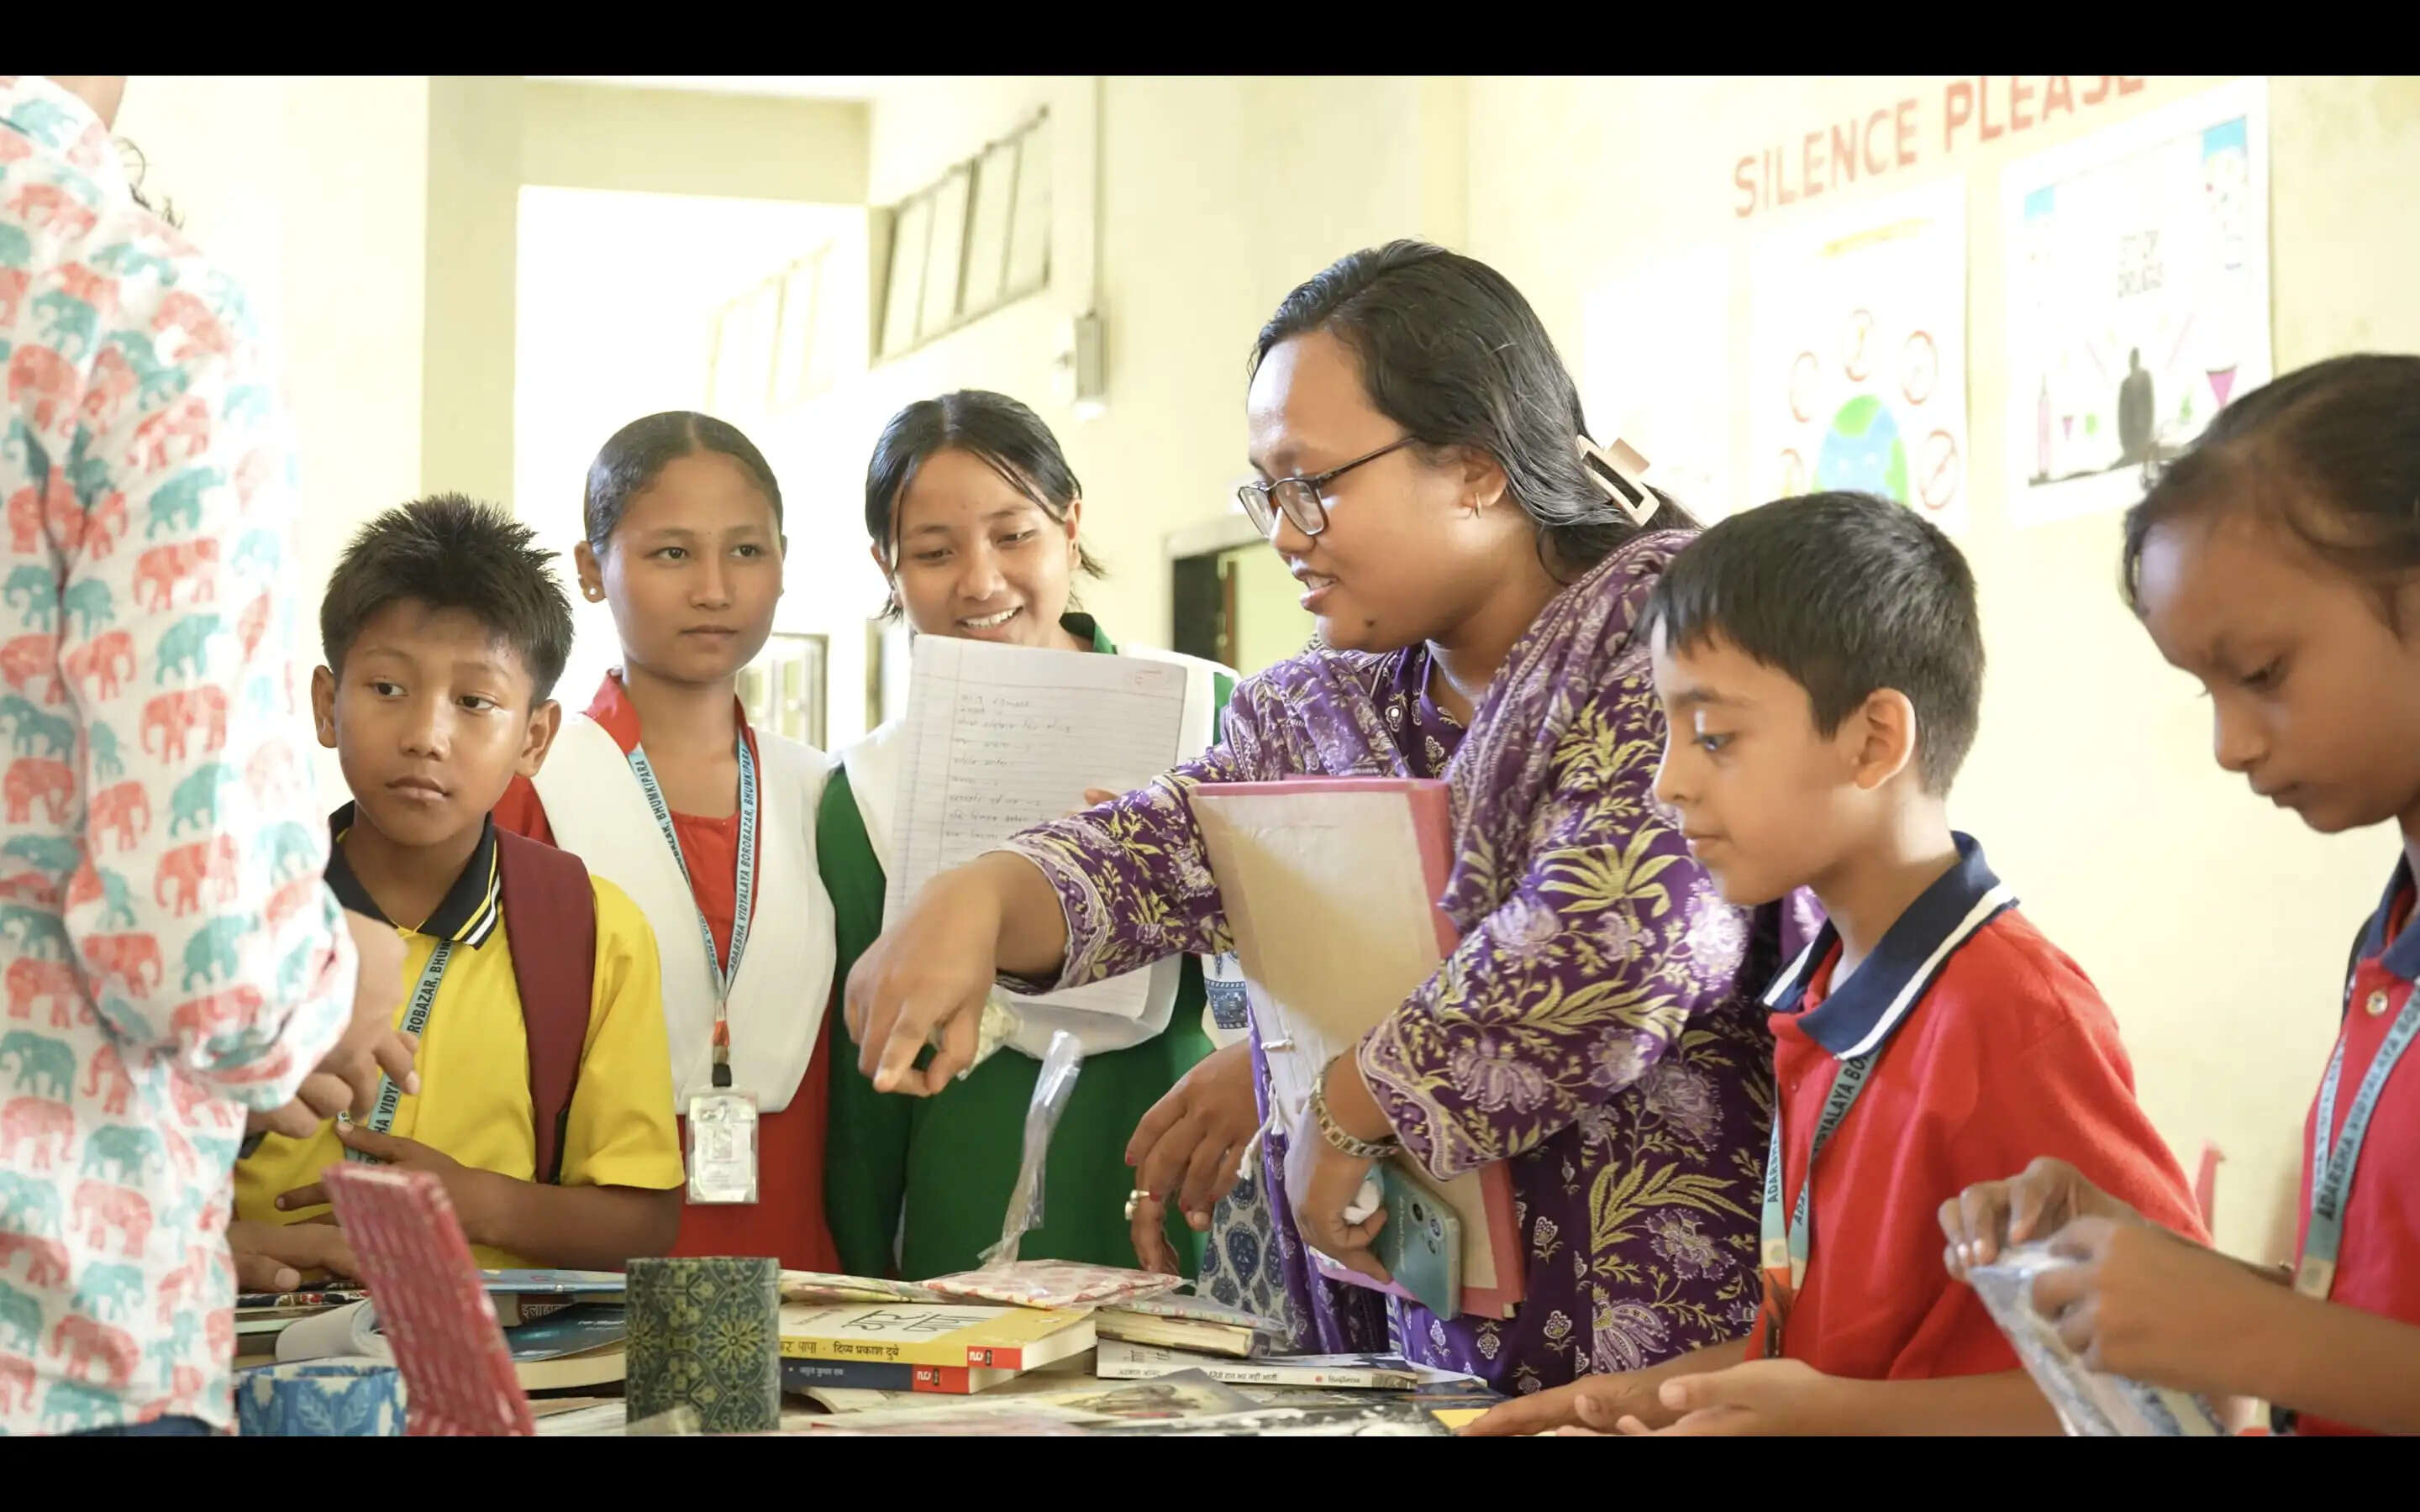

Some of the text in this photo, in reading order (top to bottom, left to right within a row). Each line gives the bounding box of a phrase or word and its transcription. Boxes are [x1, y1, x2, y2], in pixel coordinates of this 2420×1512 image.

[1734, 97, 1918, 218] SILENCE
[635, 759, 668, 822] BHUMKIPARA
[740, 808, 756, 869] BOROBAZAR,
[737, 869, 752, 921] VIDYALAYA
[729, 923, 746, 972] ADARSHA
